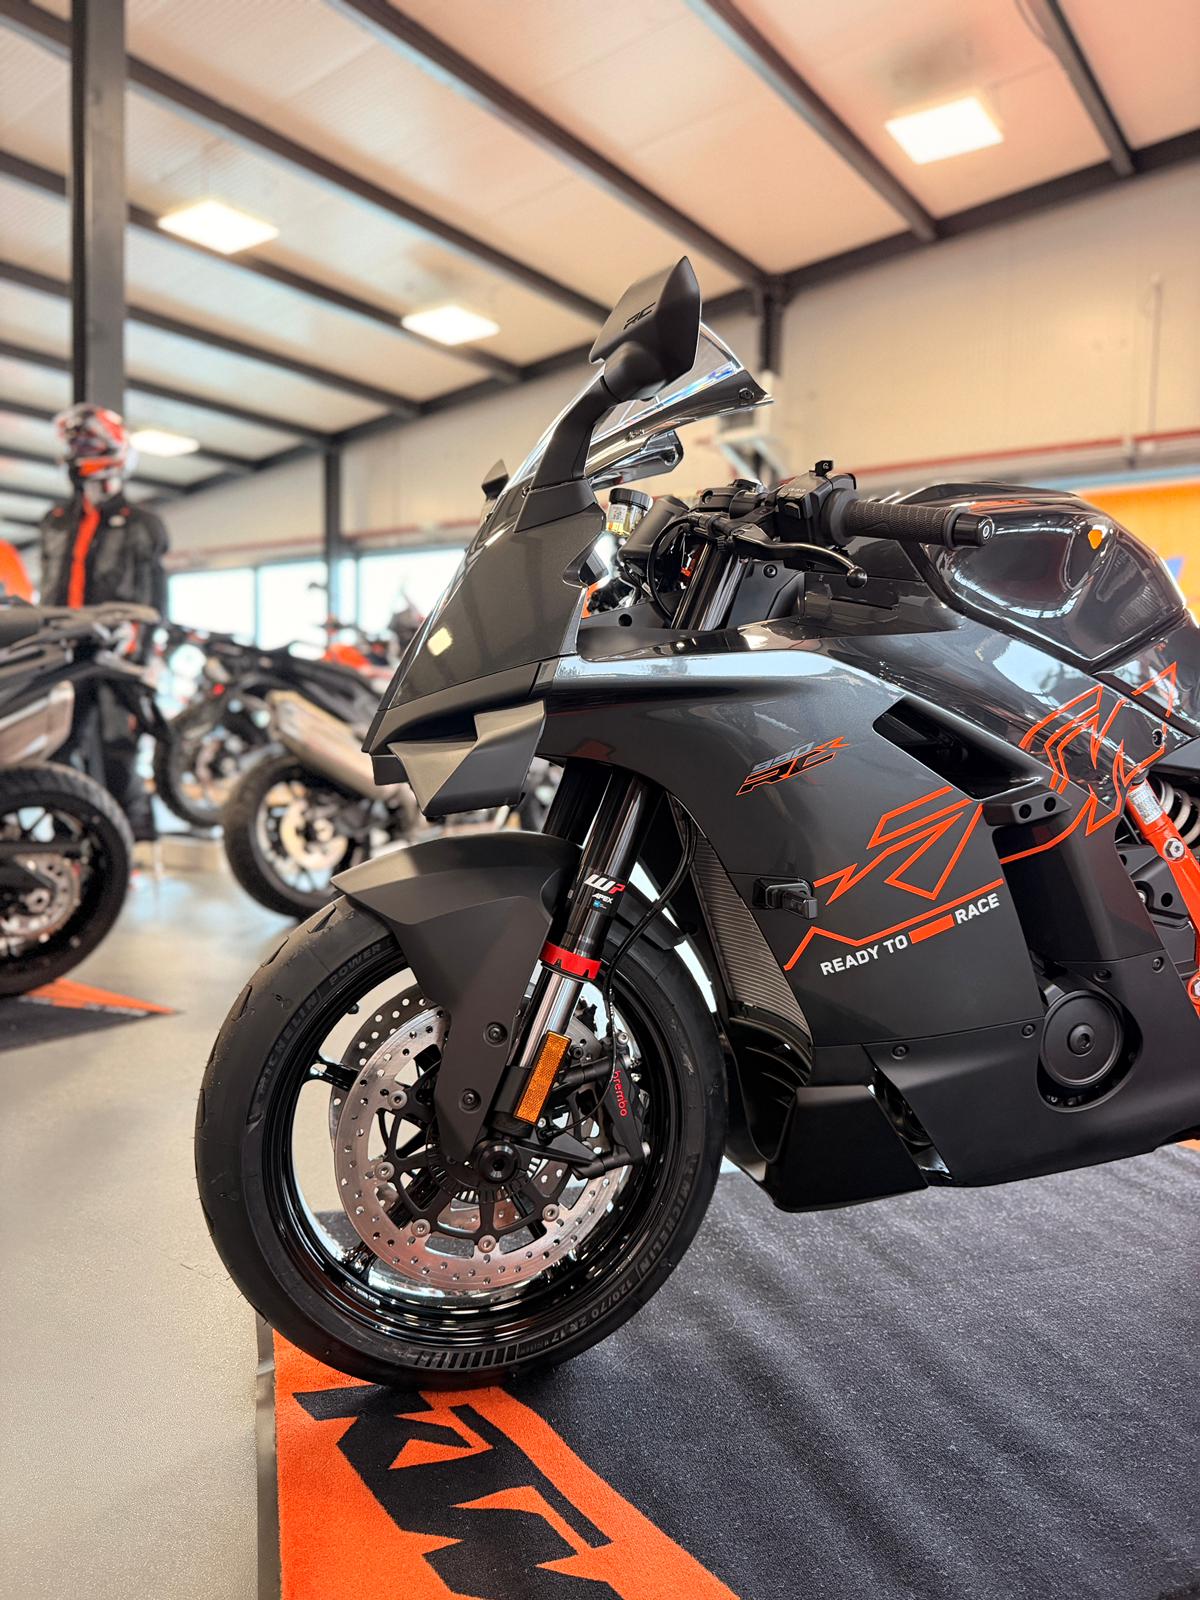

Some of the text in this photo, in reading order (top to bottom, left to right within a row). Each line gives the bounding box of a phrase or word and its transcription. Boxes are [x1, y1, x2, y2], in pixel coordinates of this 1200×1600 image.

[624, 301, 656, 330] RC
[750, 741, 816, 774] 990
[584, 874, 625, 894] WP
[592, 893, 613, 904] APEX
[820, 893, 1000, 975] READY TO RACE
[329, 943, 383, 987] POWER
[612, 1070, 628, 1117] brembo
[639, 1182, 691, 1270] MICHELIN
[591, 1279, 634, 1317] 120/70
